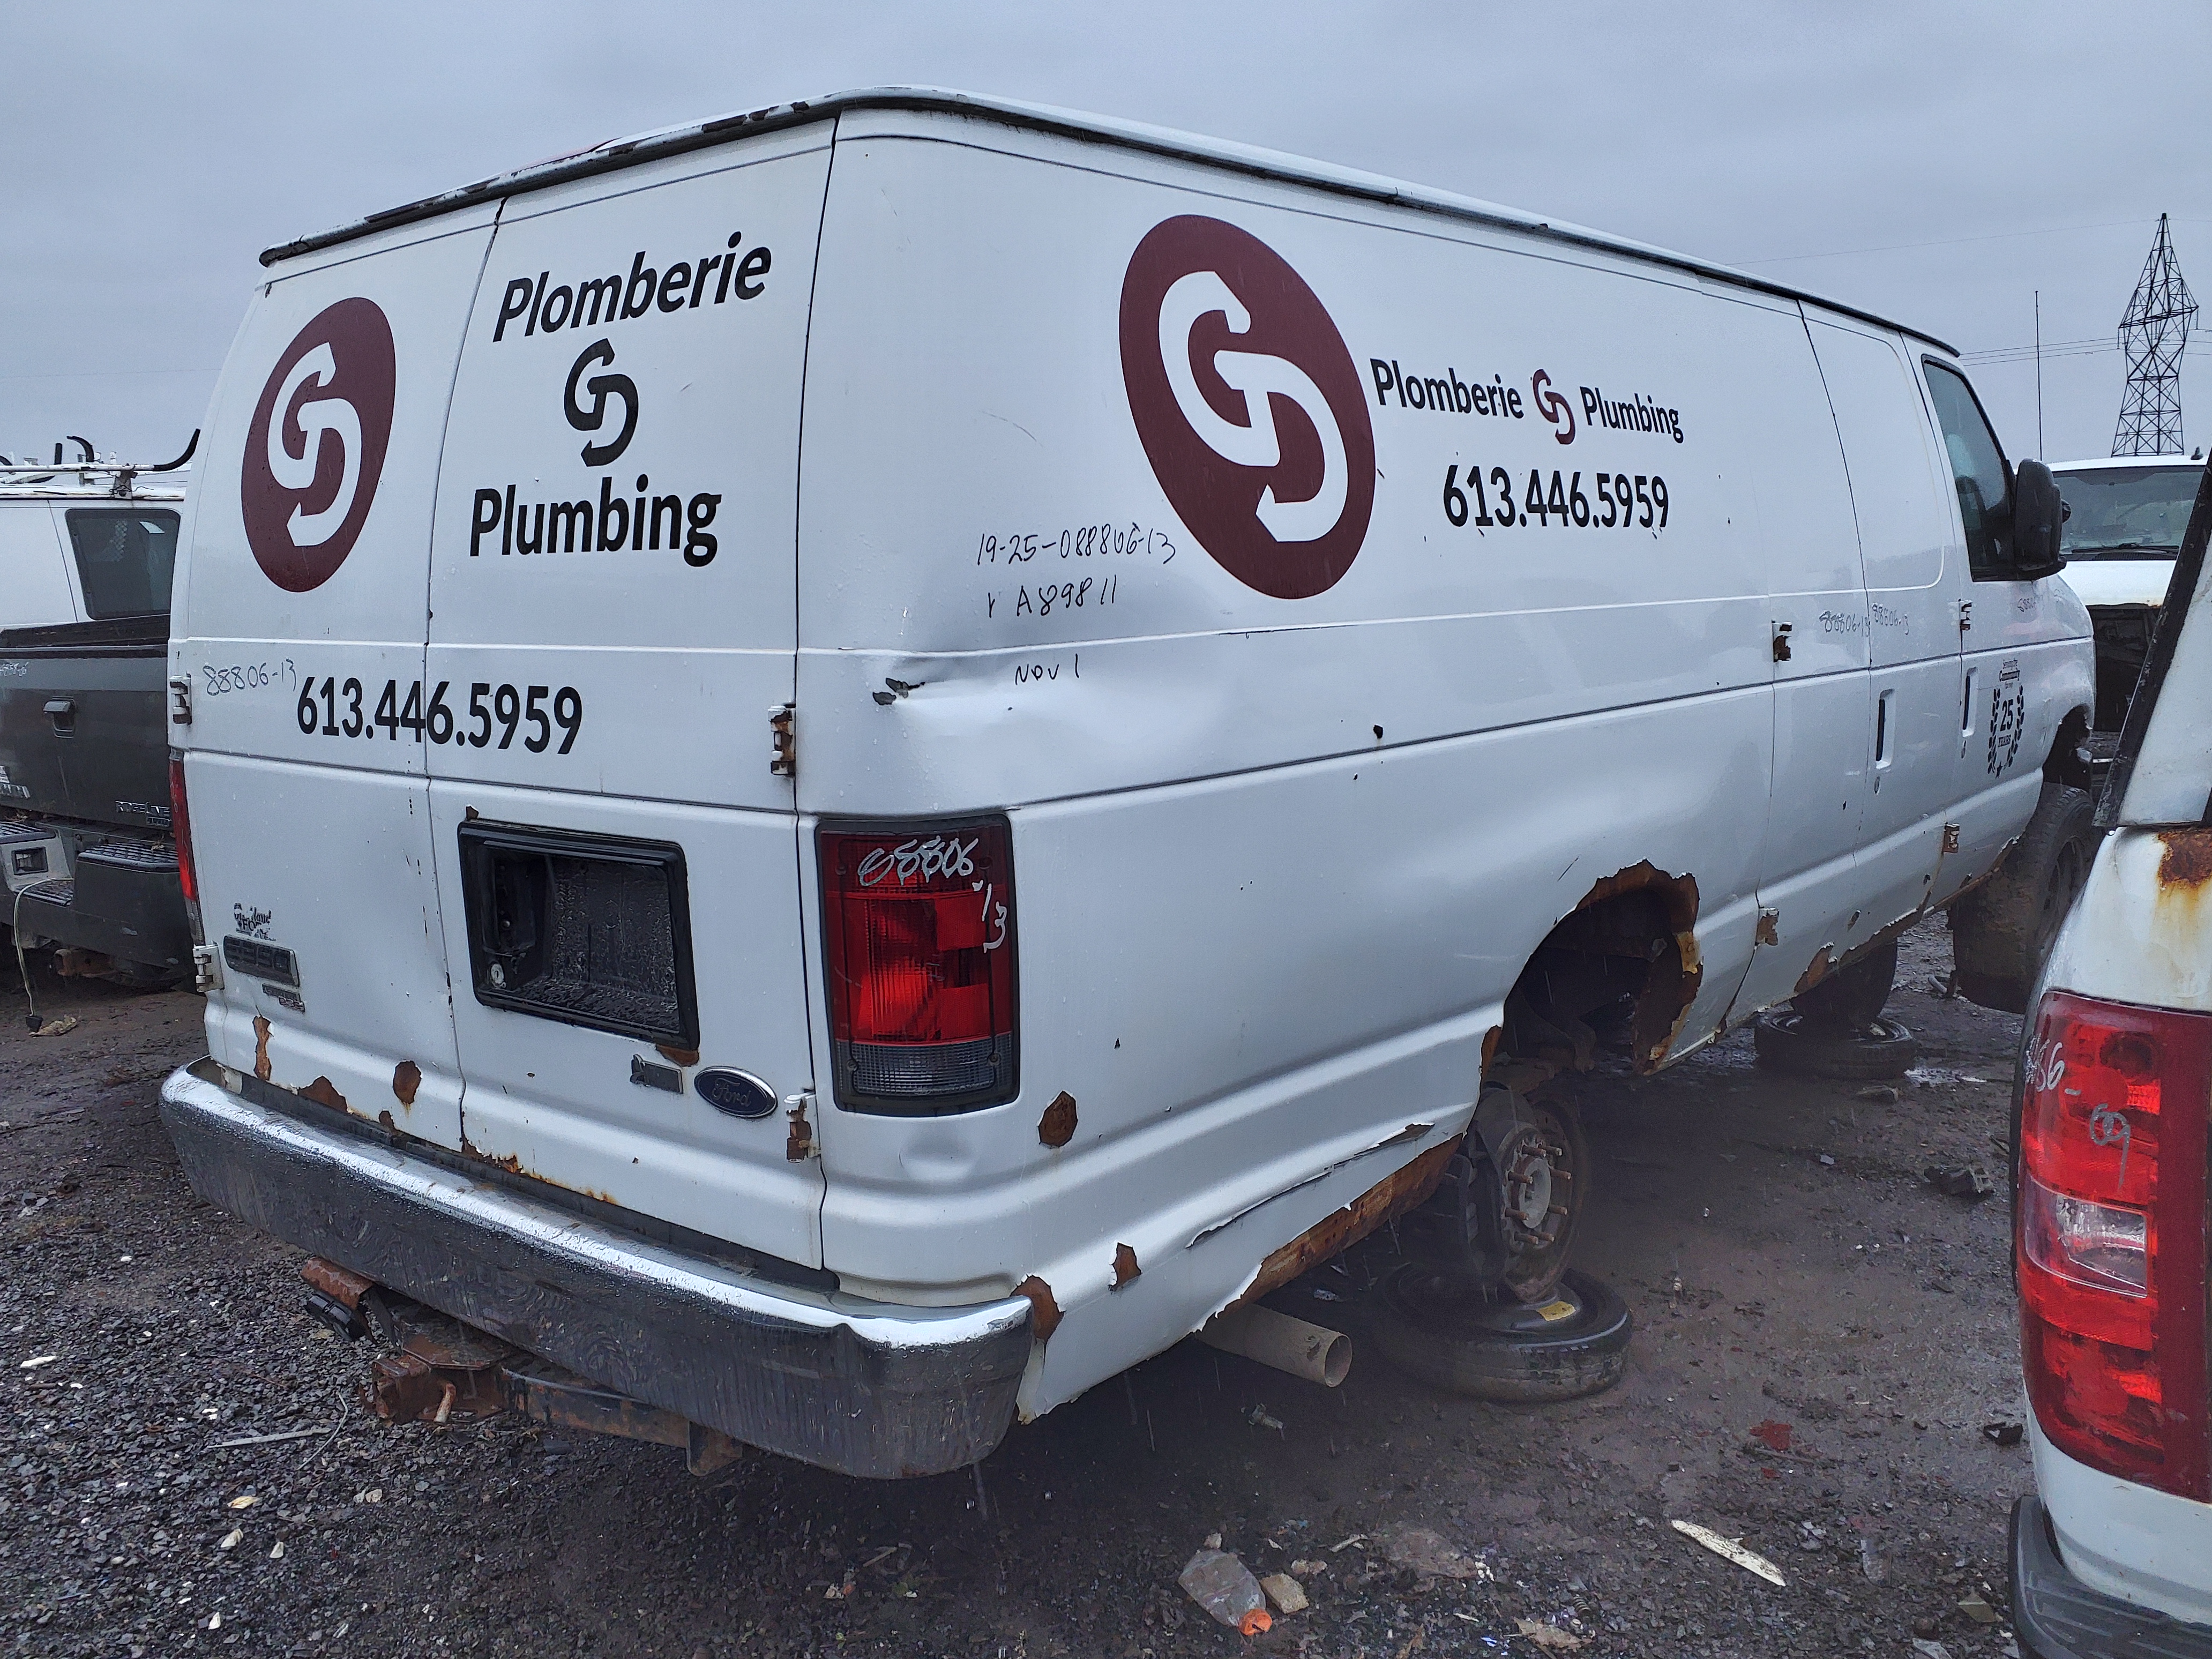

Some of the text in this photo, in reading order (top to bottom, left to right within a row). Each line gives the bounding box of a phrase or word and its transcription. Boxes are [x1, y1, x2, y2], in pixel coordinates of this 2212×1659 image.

[492, 231, 772, 342] Plomberie
[1370, 358, 1524, 419] Plomberie
[1580, 386, 1684, 444] Plumbing
[470, 474, 722, 567] Plumbing
[1443, 465, 1669, 528] 613.446.5959
[203, 658, 297, 696] 88806-13
[297, 676, 582, 755] 613.446.5959
[2000, 699, 2014, 731] 25
[711, 1078, 752, 1108] Ford
